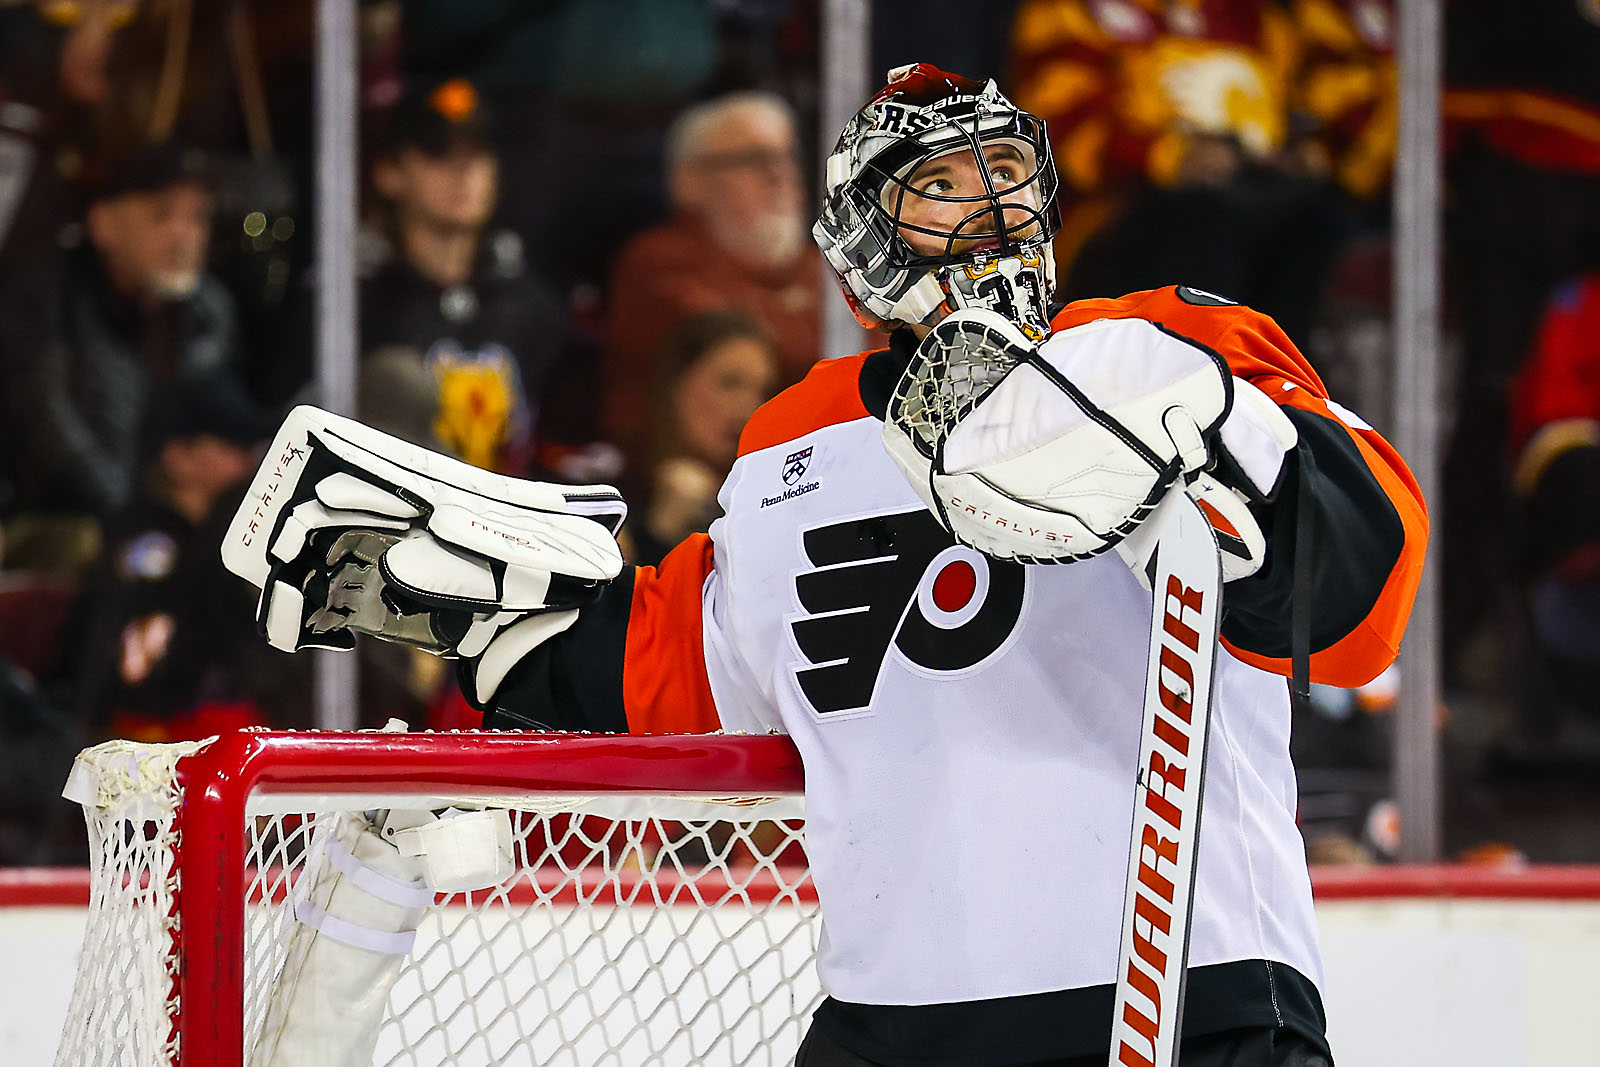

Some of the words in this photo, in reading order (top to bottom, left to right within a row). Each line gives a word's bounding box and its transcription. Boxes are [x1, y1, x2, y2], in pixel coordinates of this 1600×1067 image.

[760, 495, 782, 508] Penn
[781, 481, 820, 501] Medicine
[951, 497, 1073, 543] CATALYST
[1118, 573, 1203, 1067] WARRIOR
